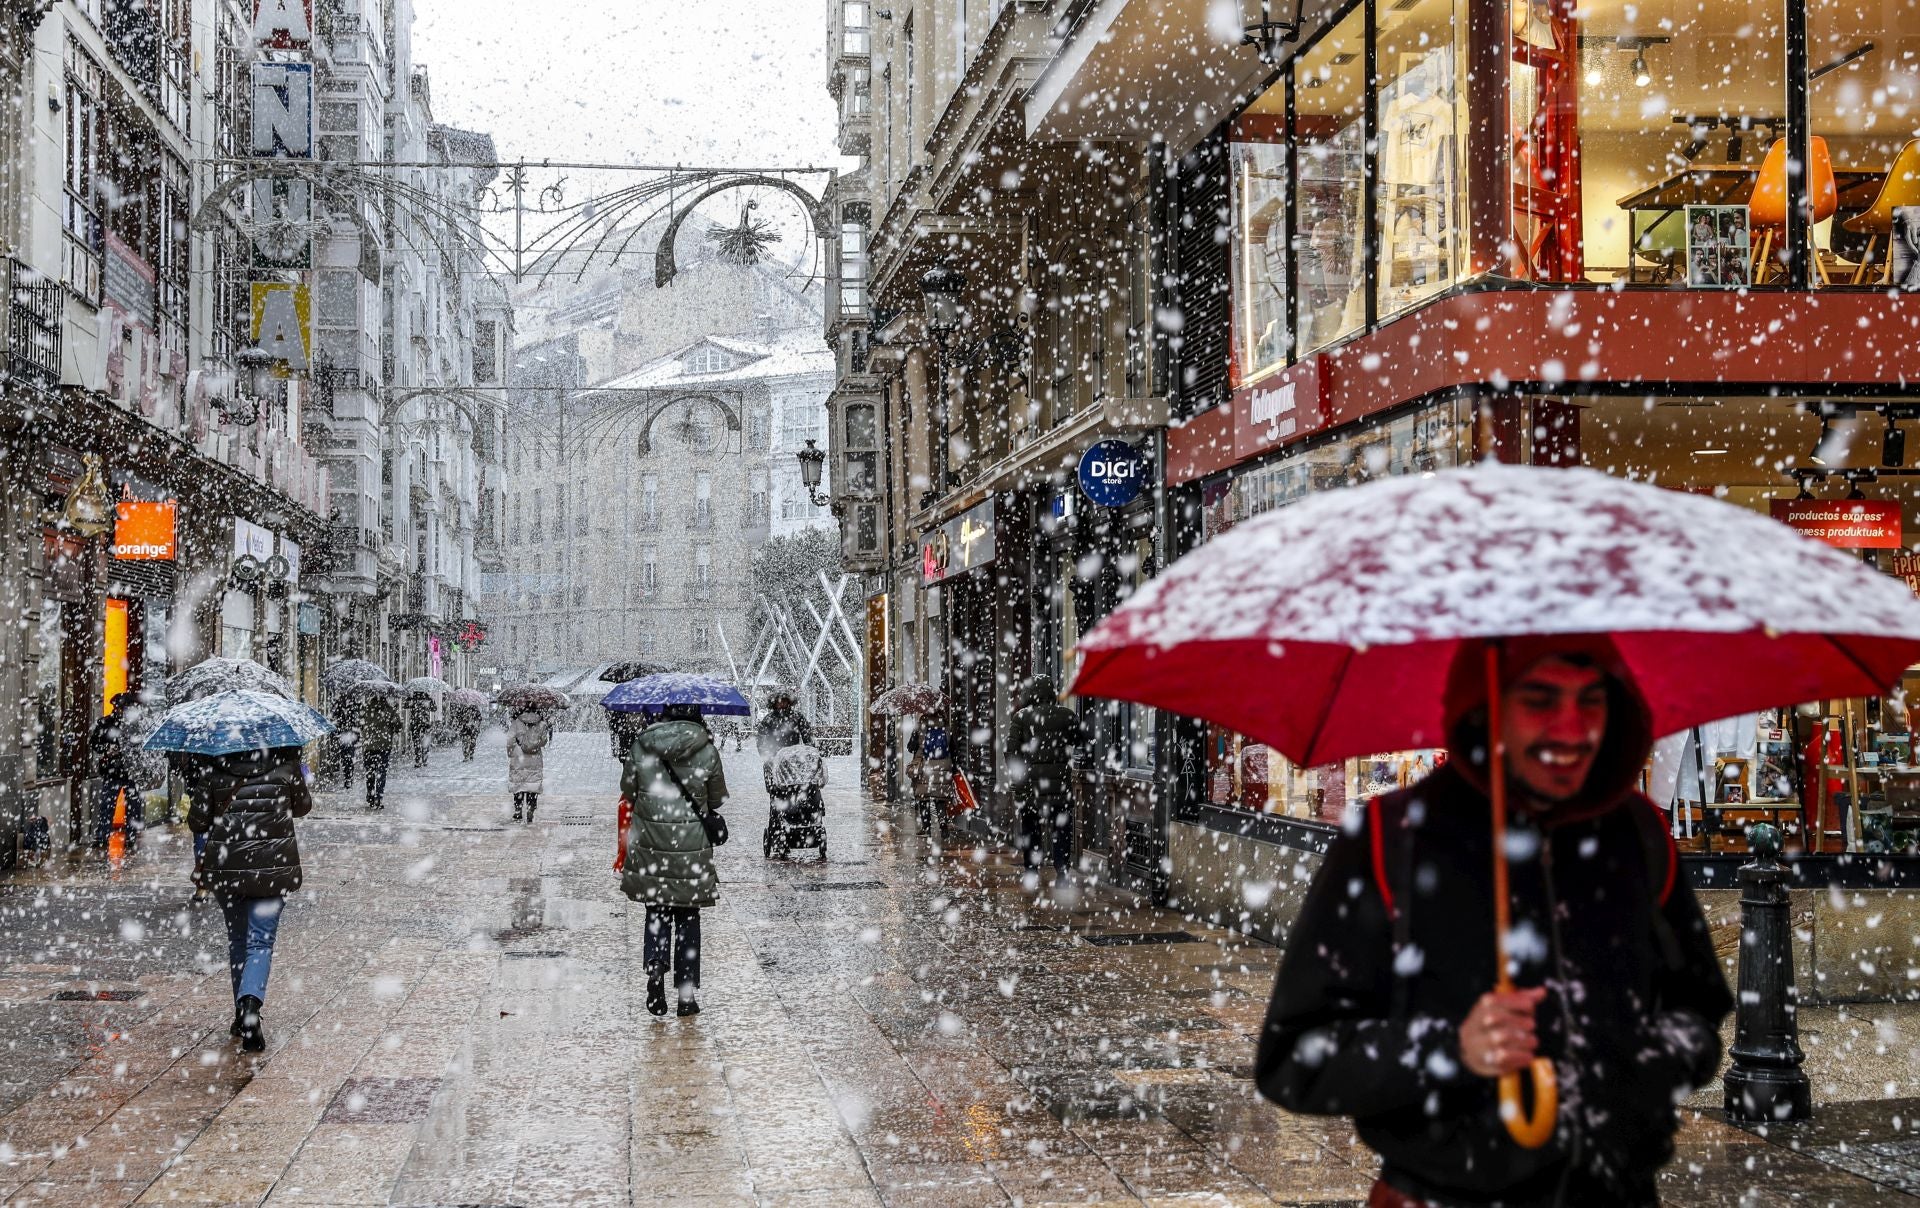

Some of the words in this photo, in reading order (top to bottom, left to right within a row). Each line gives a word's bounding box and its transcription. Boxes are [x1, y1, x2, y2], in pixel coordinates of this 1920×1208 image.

[1091, 460, 1135, 478] DIGI
[1788, 510, 1840, 521] productos
[1827, 526, 1884, 538] produktuak
